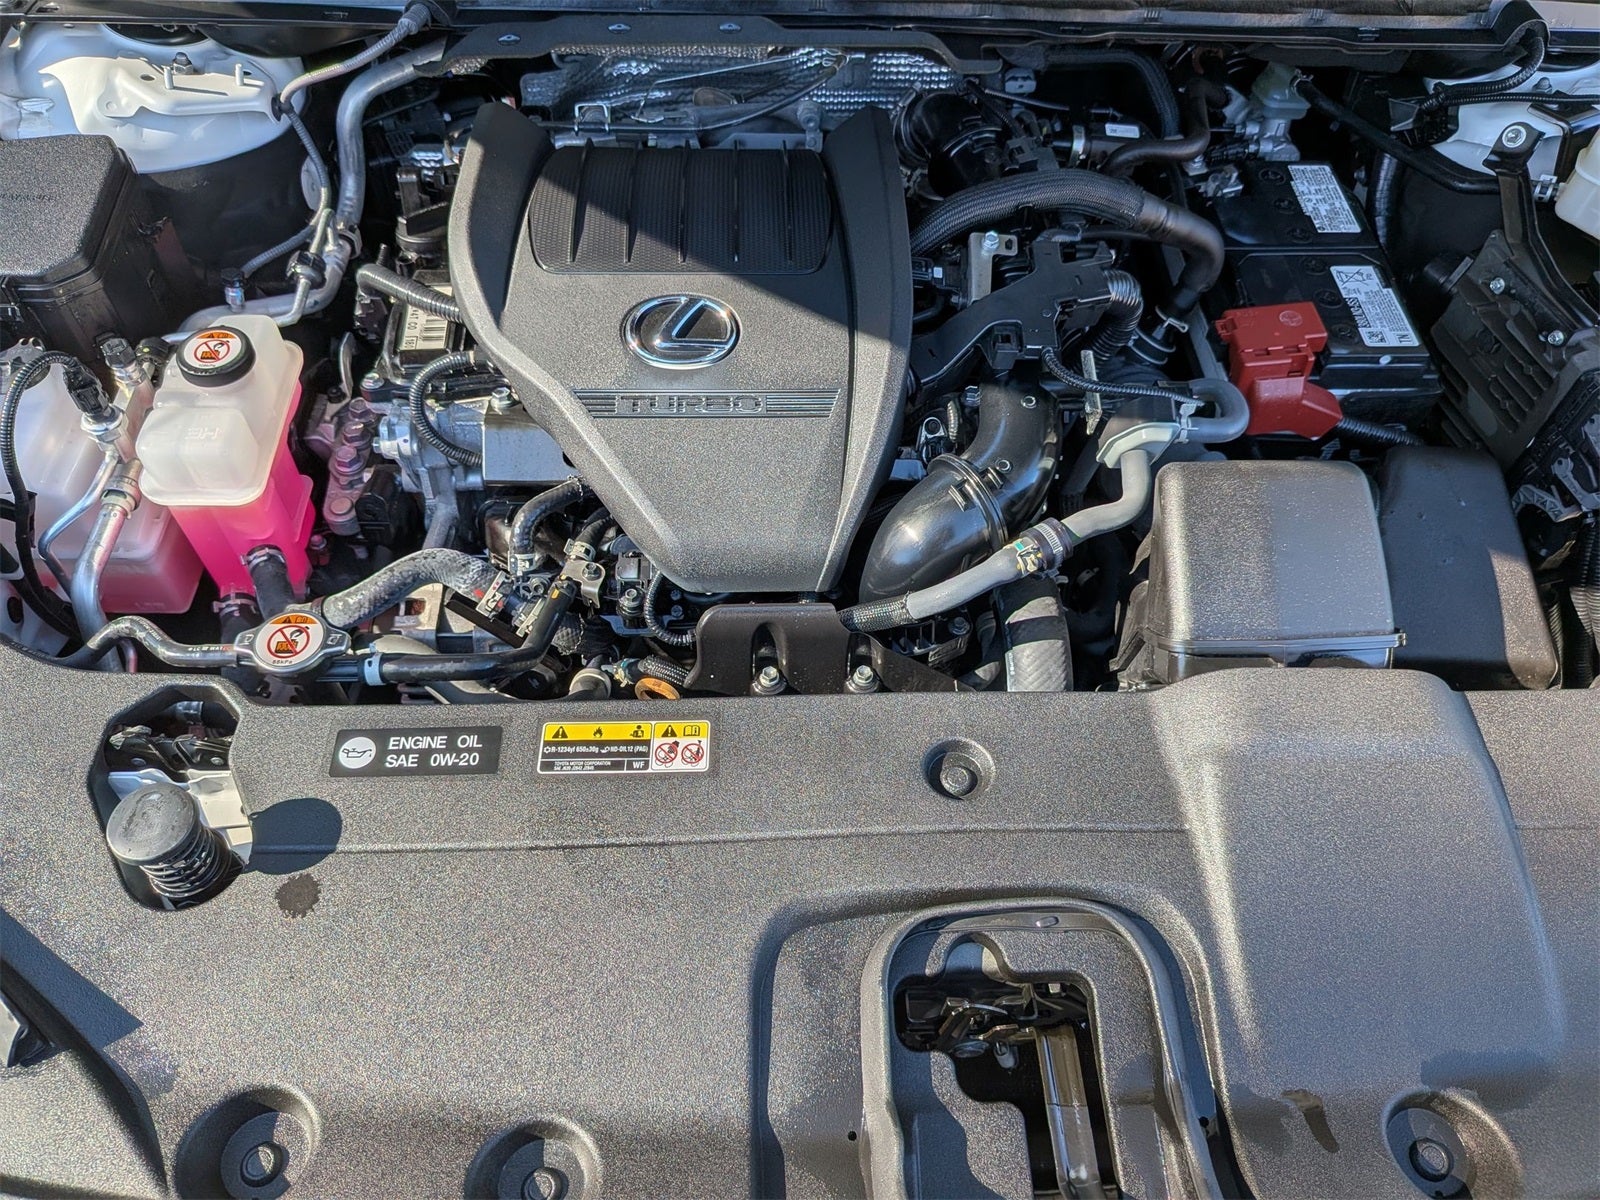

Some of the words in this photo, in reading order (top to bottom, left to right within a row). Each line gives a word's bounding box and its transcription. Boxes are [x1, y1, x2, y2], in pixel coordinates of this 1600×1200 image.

[619, 394, 763, 413] TURBO
[388, 735, 448, 750] ENGINE
[457, 735, 483, 748] OIL
[384, 754, 419, 768] SAE
[430, 753, 480, 767] 0W-20
[632, 761, 645, 769] WF
